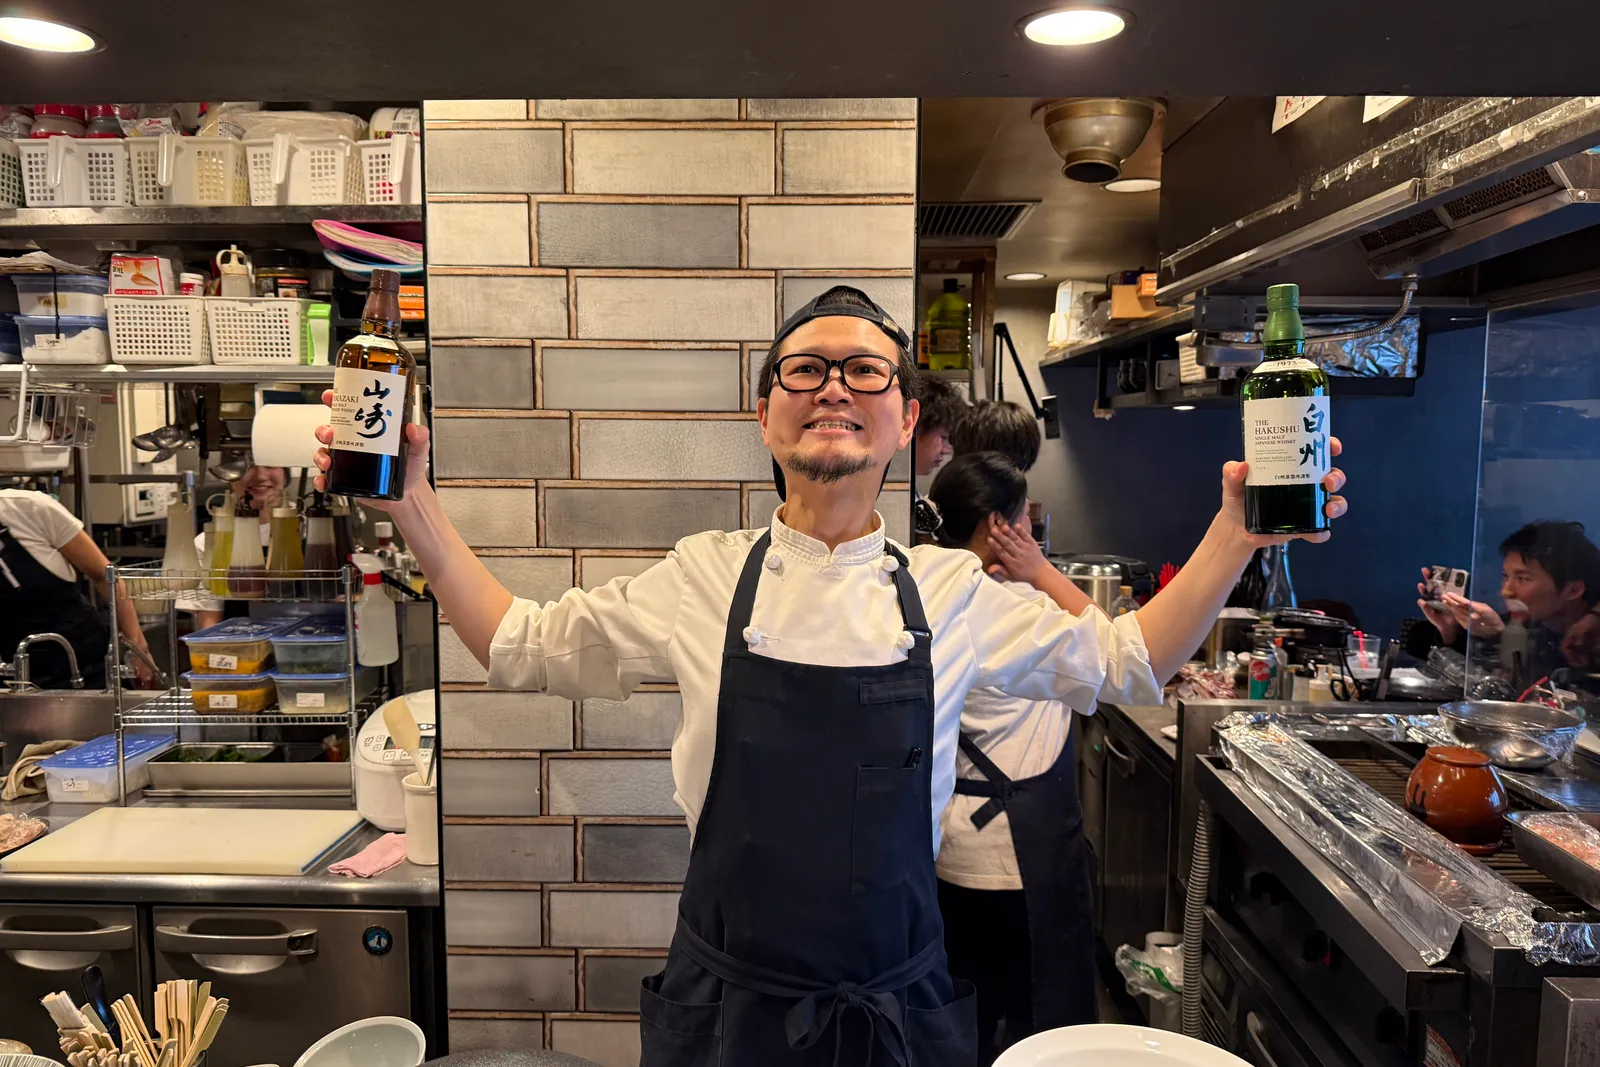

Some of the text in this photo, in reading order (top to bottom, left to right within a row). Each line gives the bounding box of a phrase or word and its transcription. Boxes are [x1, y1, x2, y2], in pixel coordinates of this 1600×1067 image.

[354, 379, 392, 438] 山崎
[1254, 425, 1301, 435] HAKUSHU
[1299, 403, 1326, 472] 白州
